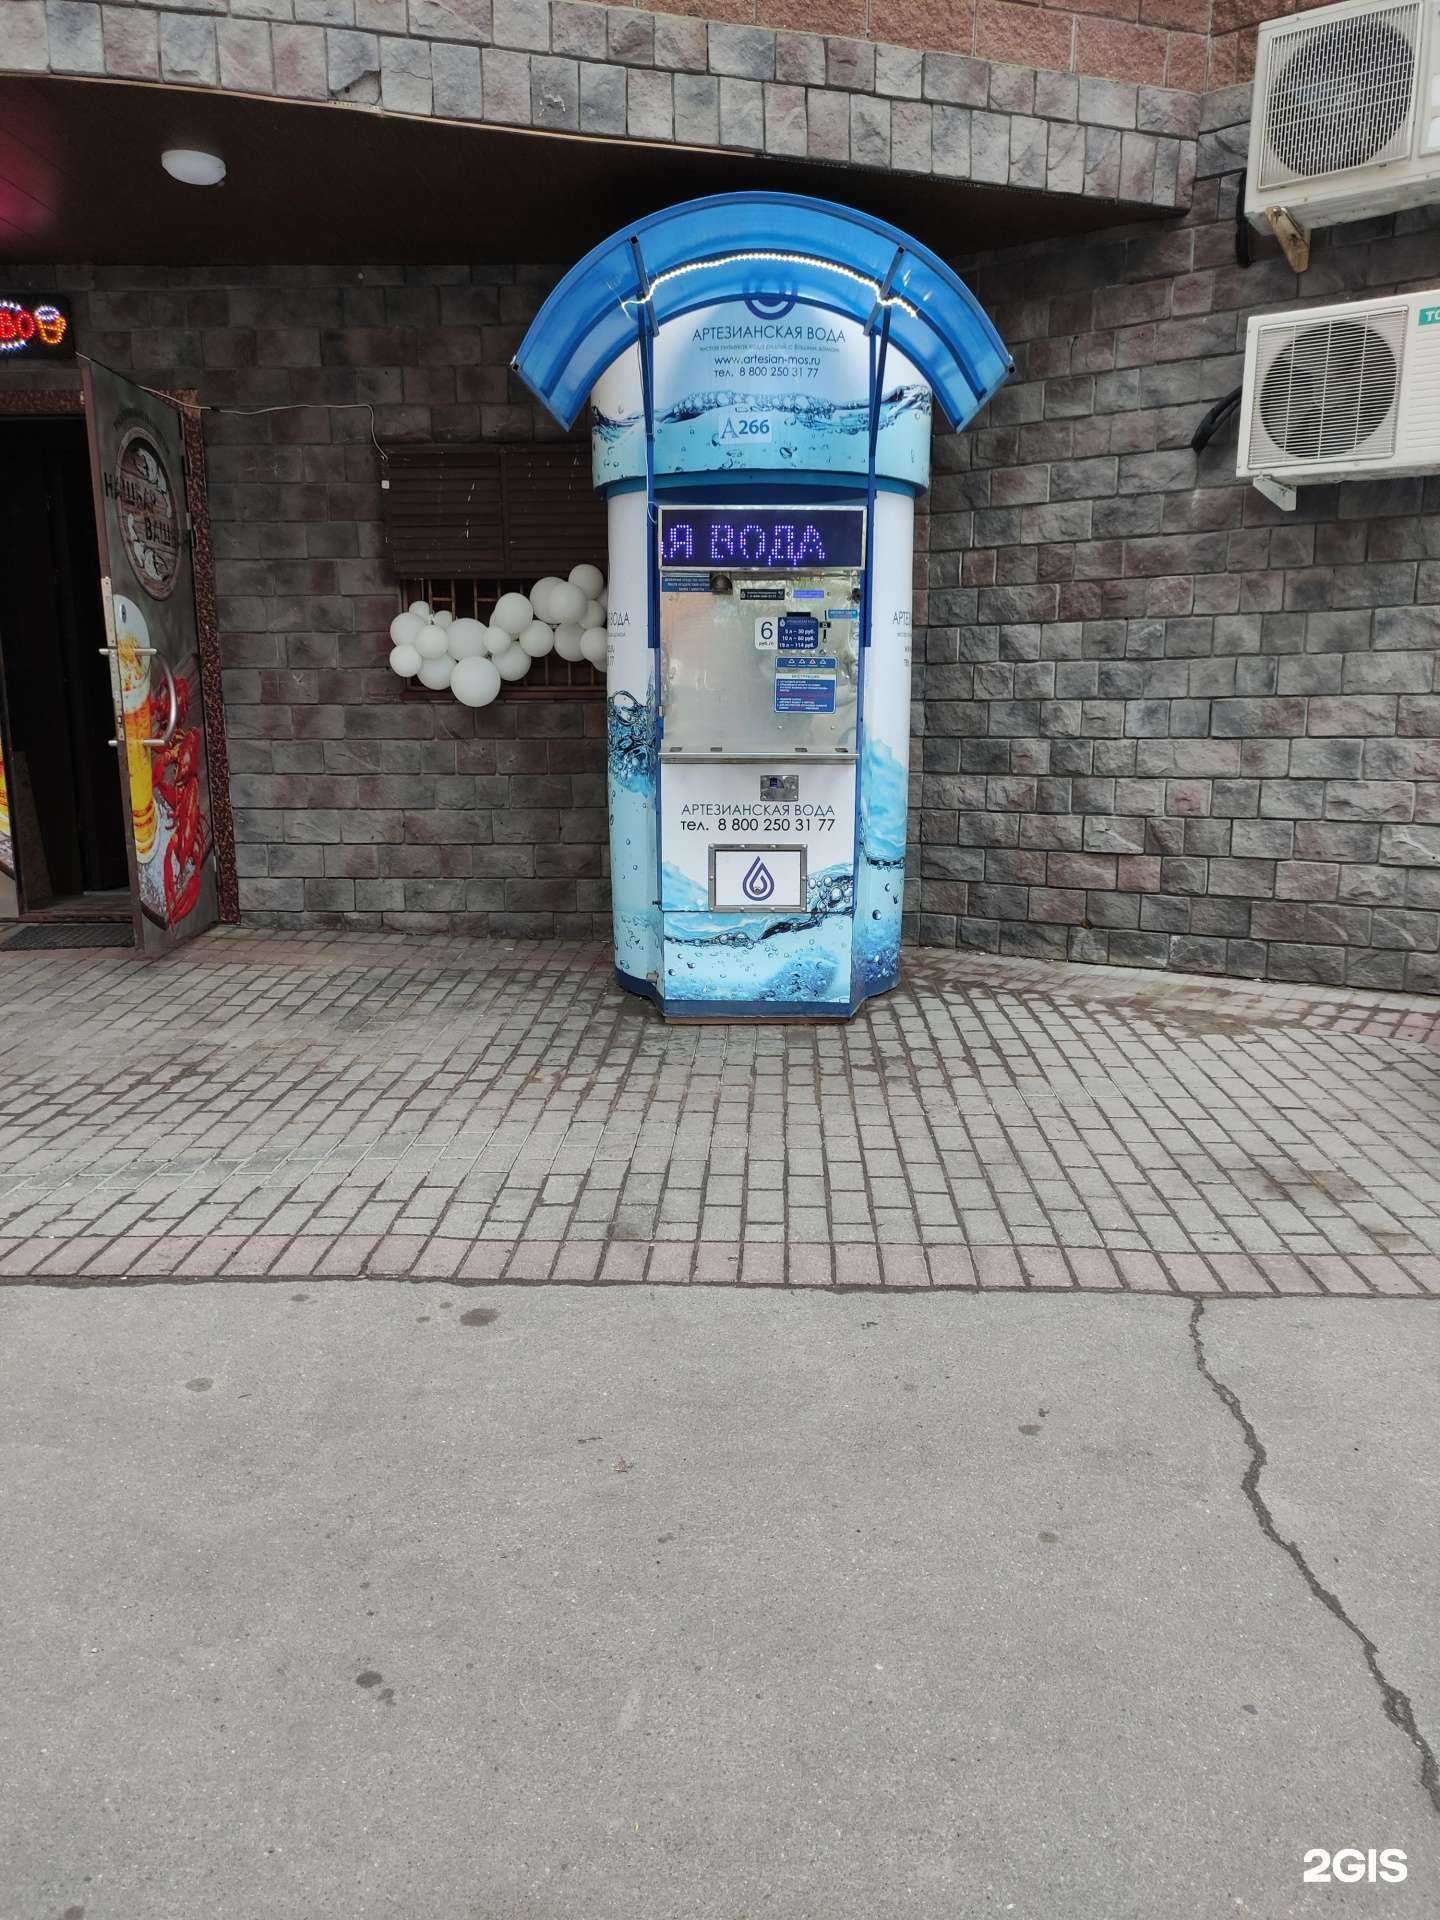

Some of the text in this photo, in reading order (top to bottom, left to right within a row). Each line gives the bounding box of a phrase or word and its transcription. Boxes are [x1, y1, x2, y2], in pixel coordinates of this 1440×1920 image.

[692, 325, 846, 343] АРТЕЗИАНСКАЯ ВОДА
[714, 353, 821, 366] www.artesian-mos.ru
[714, 367, 819, 378] тел. 8 800 250 31 77
[711, 523, 826, 566] ВОДА
[761, 621, 773, 640] 6
[681, 804, 835, 818] АРТЕЗИАНСКАЯ ВОДА
[681, 818, 836, 831] тел. 8 800 250 31 77
